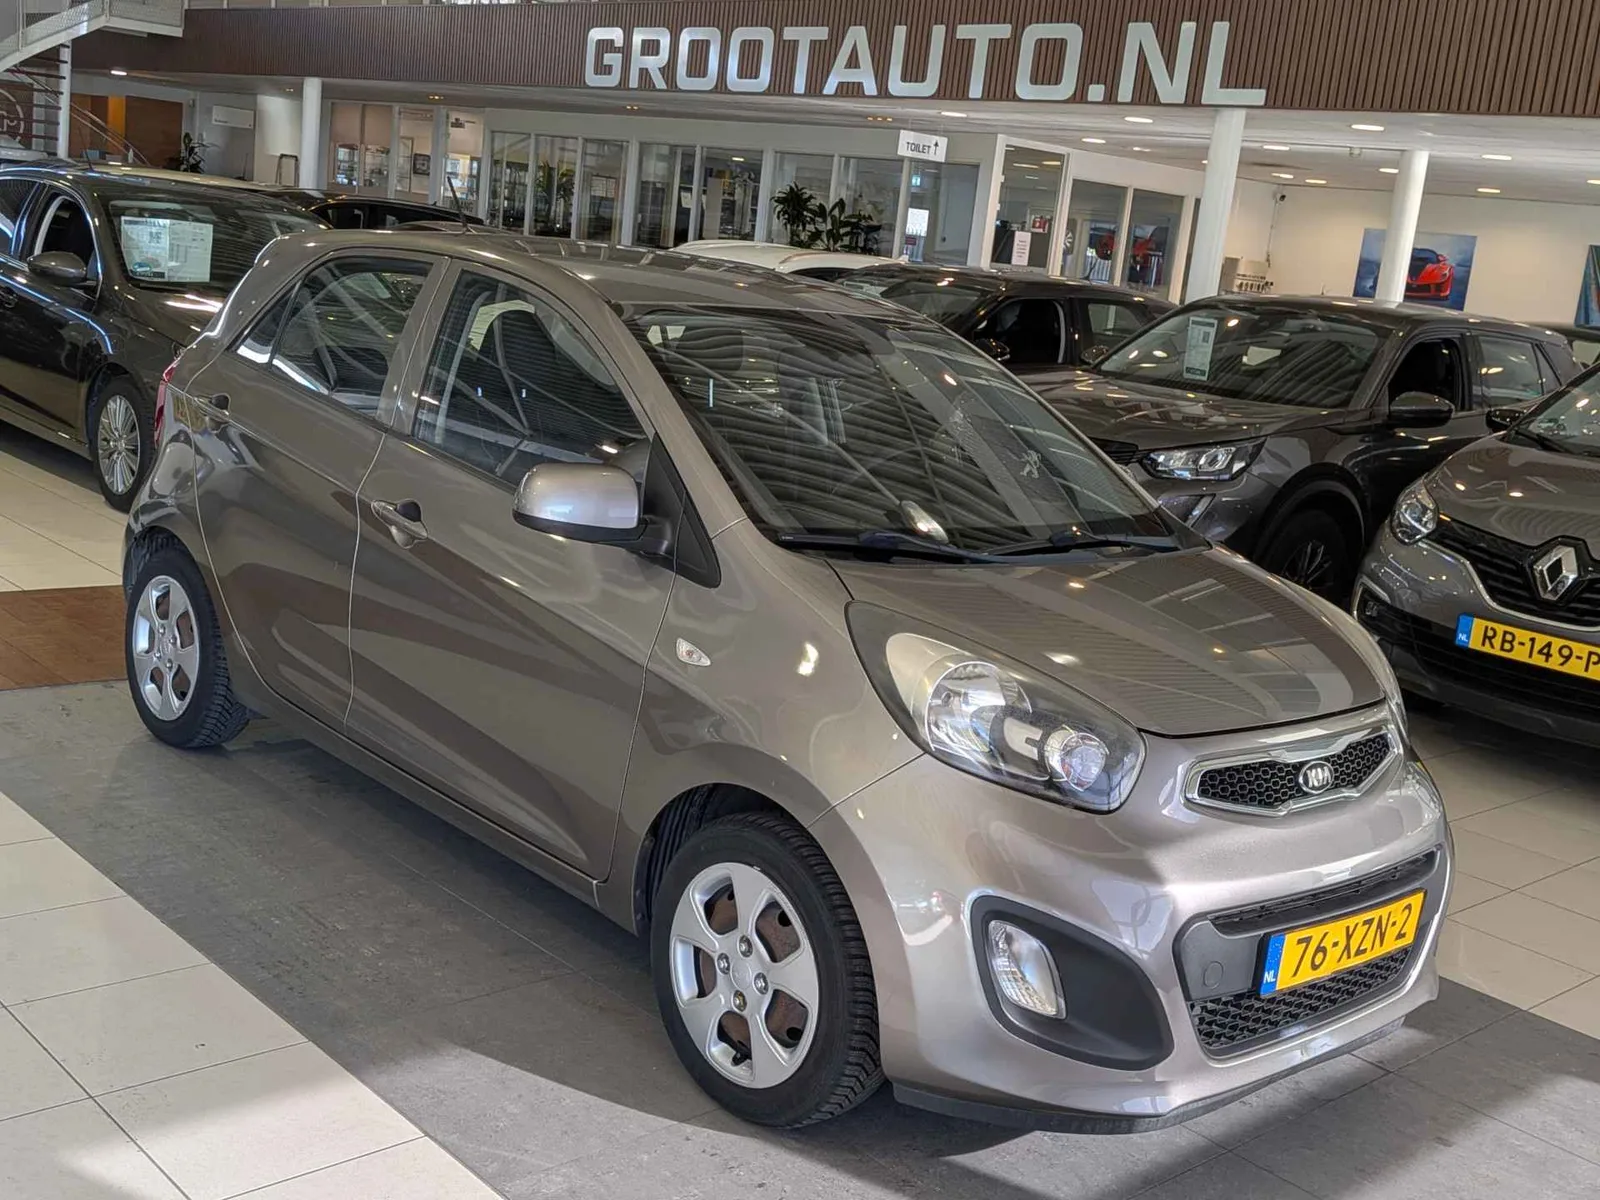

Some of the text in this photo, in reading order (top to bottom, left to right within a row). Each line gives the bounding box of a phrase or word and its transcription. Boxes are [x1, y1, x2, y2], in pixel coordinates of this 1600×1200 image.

[584, 21, 1266, 106] GROOTAUTO.NL
[906, 141, 931, 155] TOILET
[1458, 632, 1468, 642] NL
[1481, 625, 1600, 673] RB-149-P
[1306, 766, 1331, 788] KIA
[1291, 903, 1412, 977] 76-XZN-2
[1263, 969, 1276, 984] NL
